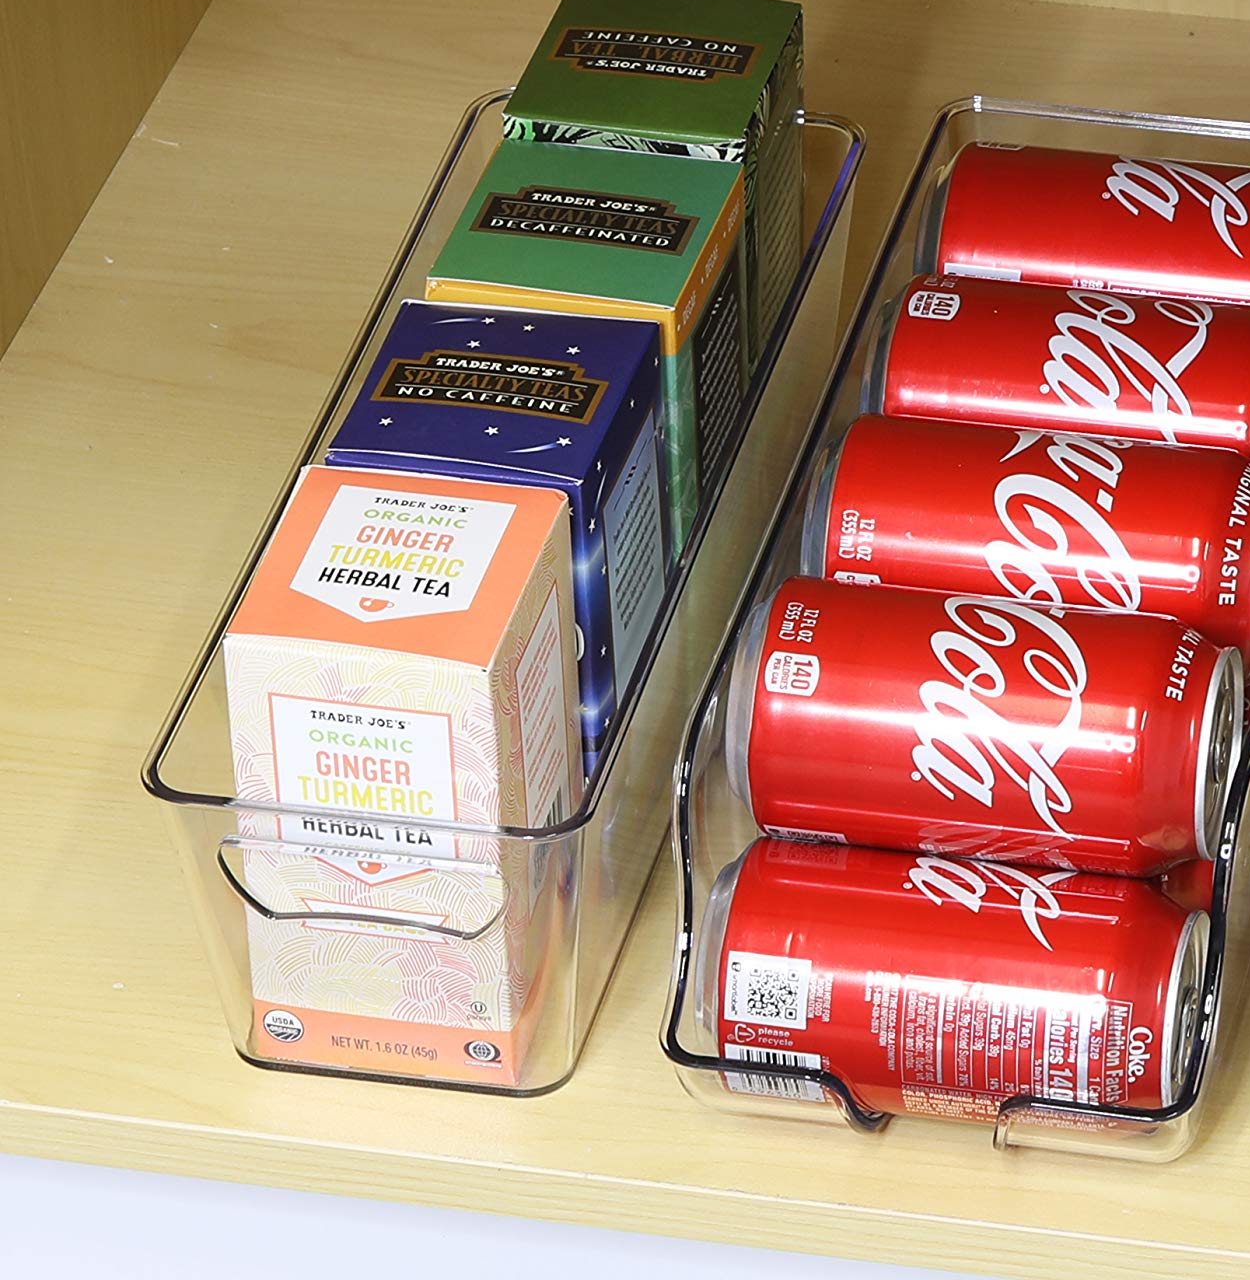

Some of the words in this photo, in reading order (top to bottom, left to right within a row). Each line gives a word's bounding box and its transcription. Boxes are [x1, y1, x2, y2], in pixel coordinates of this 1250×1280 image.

[571, 41, 618, 58] TEA
[584, 31, 693, 48] CAFFEINE
[704, 40, 738, 53] NO
[594, 58, 642, 70] JOE'S
[639, 46, 739, 71] HERBAL
[645, 62, 708, 78] TRADER
[531, 192, 596, 208] TRADER
[599, 199, 650, 213] JOE'S
[501, 203, 617, 229] SPECIALTY
[621, 216, 679, 236] TEAS
[489, 218, 671, 248] DECAFFEINATED
[931, 296, 956, 317] 140
[435, 357, 502, 372] TRADER
[505, 363, 557, 377] JOE'S
[403, 368, 523, 395] SPECIALTY
[528, 380, 587, 402] TEAS
[397, 386, 434, 400] NO
[445, 389, 579, 415] CAFFEINE
[374, 496, 427, 510] TRADER
[430, 501, 468, 513] JOE'S
[363, 509, 469, 530] ORGANIC
[840, 509, 860, 535] (355
[859, 518, 876, 531] 12
[356, 524, 455, 554] GINGER
[327, 544, 465, 578] TURMERIC
[855, 545, 873, 562] OZ
[317, 566, 402, 591] HERBAL
[411, 576, 451, 598] TEA
[1216, 537, 1244, 607] TASTE
[784, 601, 805, 620] (355
[778, 620, 796, 641] mL)
[796, 629, 814, 643] OZ
[790, 660, 814, 690] 140
[1165, 642, 1197, 703] TASTE
[310, 709, 364, 725] TRADER
[367, 716, 406, 731] JOE'S
[308, 728, 414, 754] ORGANIC
[315, 750, 412, 786] GINGER
[297, 776, 434, 817] TURMERIC
[271, 1016, 295, 1027] USDA
[757, 1027, 791, 1039] please
[331, 1035, 352, 1048] NET
[355, 1038, 373, 1052] WT.
[375, 1041, 392, 1054] 1.6
[394, 1044, 409, 1055] OZ
[410, 1045, 438, 1061] (45g)
[757, 1037, 795, 1048] recycle
[1089, 1036, 1103, 1060] Size
[1105, 1005, 1129, 1067] Nutrition
[1126, 1026, 1154, 1084] Coke.
[1048, 1068, 1074, 1103] 140
[1105, 1069, 1124, 1103] Facts
